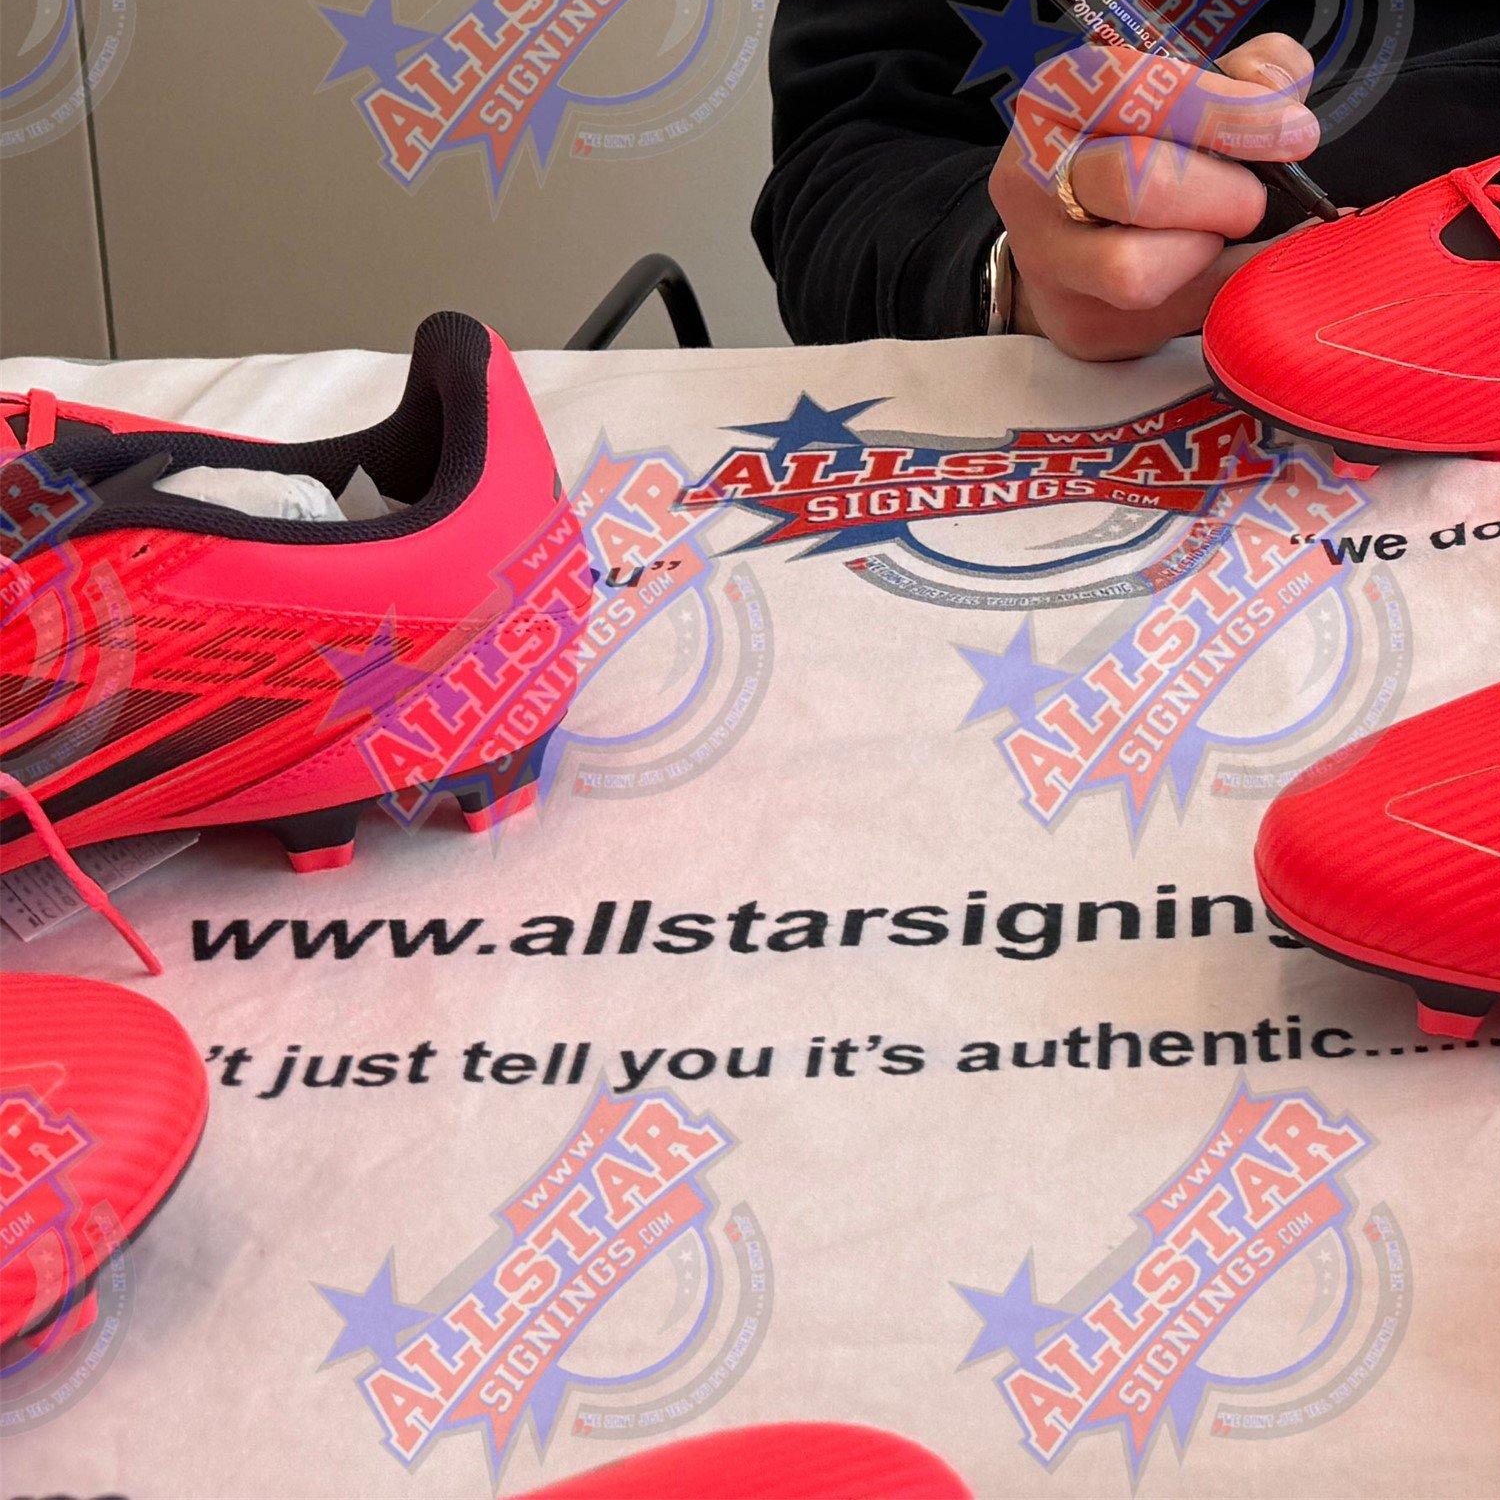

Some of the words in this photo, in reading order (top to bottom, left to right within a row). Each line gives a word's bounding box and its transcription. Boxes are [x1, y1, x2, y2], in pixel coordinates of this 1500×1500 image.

[681, 410, 1280, 504] ALLSTAR
[807, 477, 1097, 522] SIGNINGS
[255, 1040, 437, 1100] just
[462, 1040, 590, 1085] tell
[603, 1045, 774, 1093] you
[804, 1032, 926, 1079] it’s
